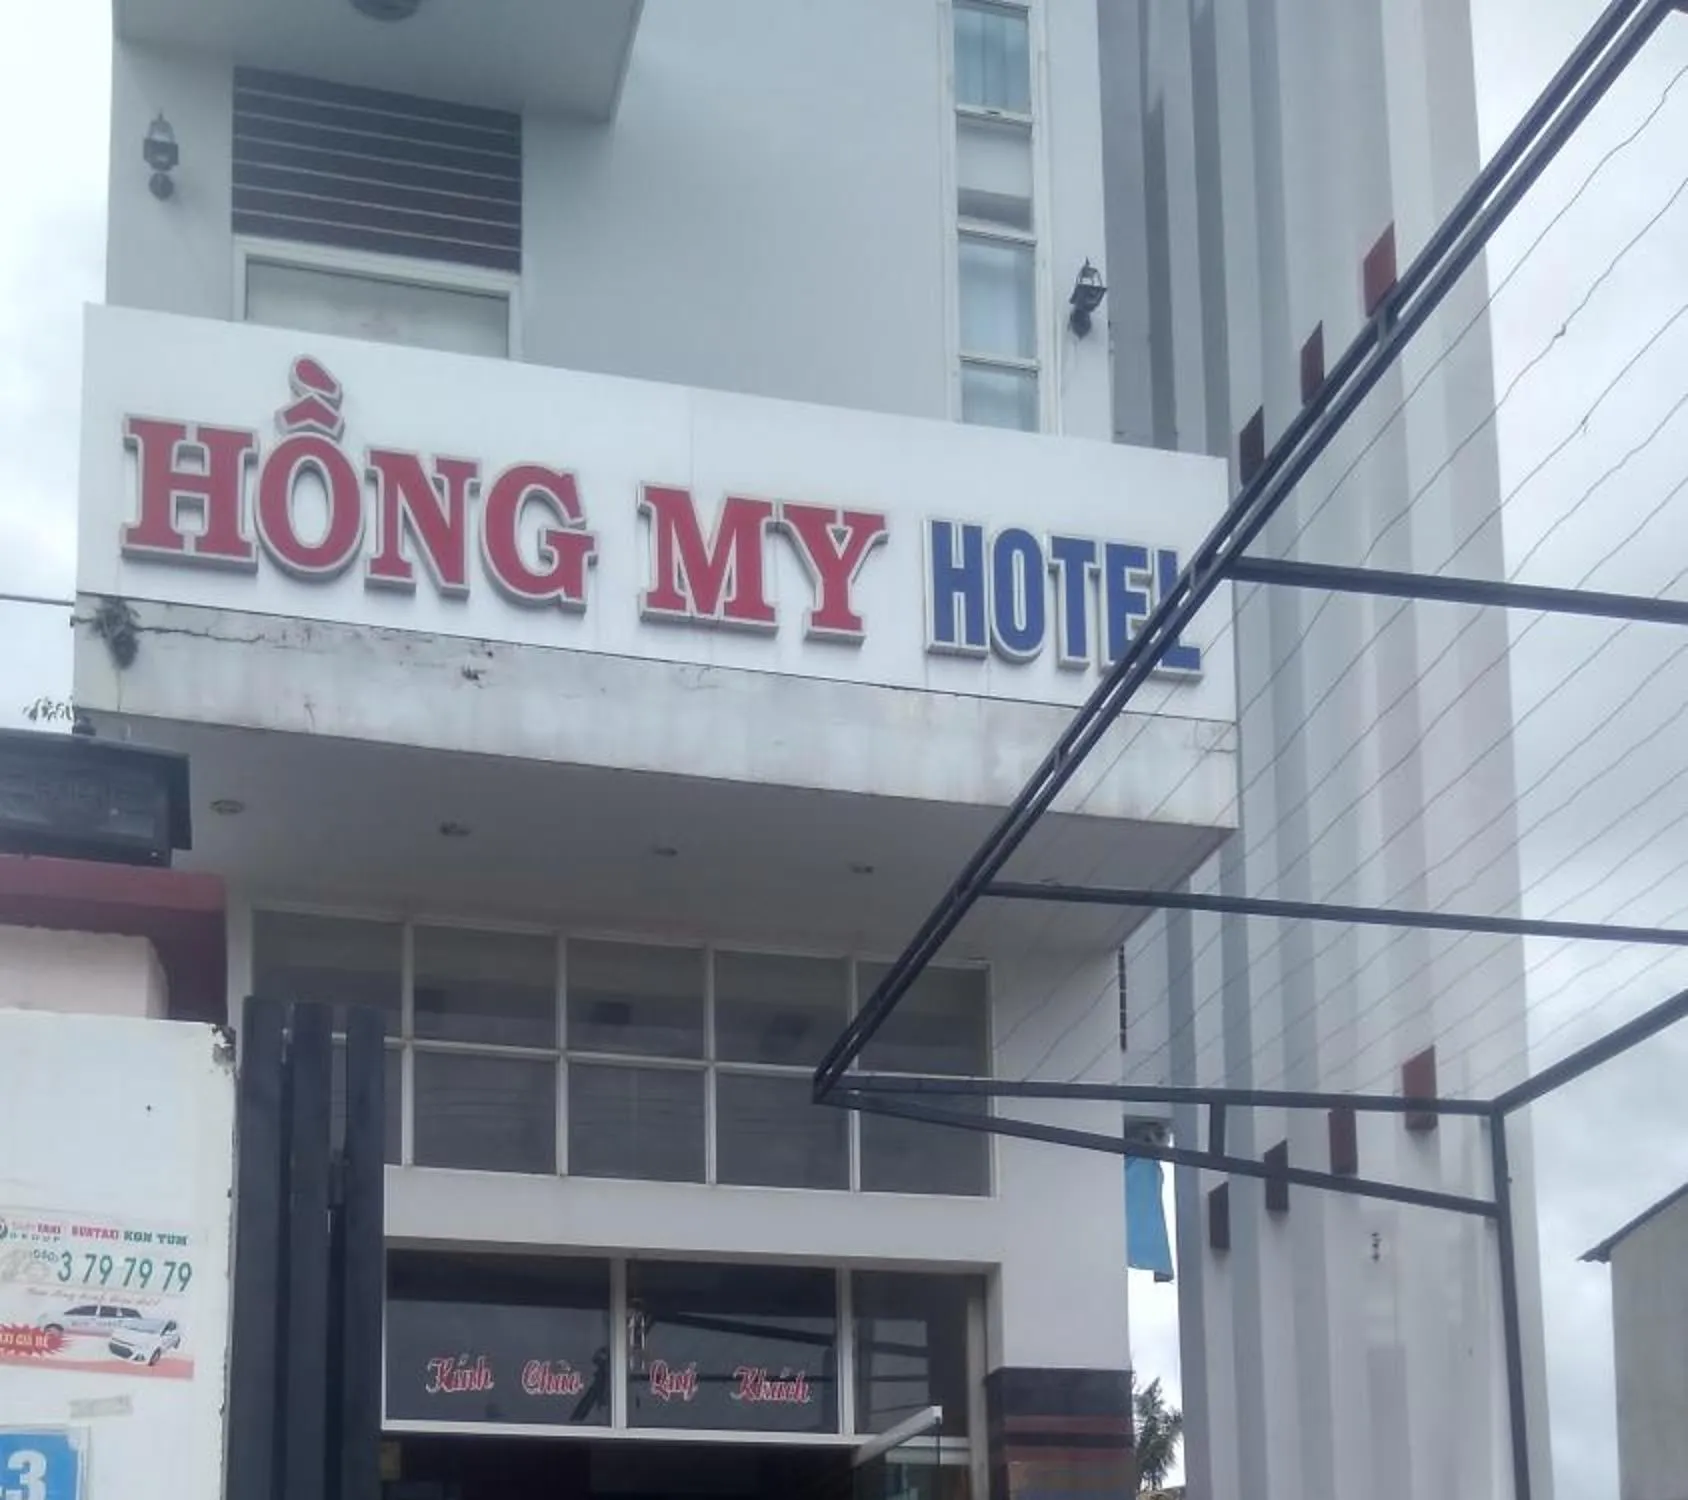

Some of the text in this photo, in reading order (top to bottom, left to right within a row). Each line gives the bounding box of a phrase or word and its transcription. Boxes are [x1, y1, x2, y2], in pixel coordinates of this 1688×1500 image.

[121, 355, 1202, 681] HỒNG MY HOTEL
[57, 1251, 73, 1282] 3
[82, 1253, 113, 1286] 79
[122, 1257, 153, 1289] 79
[162, 1261, 193, 1293] 79
